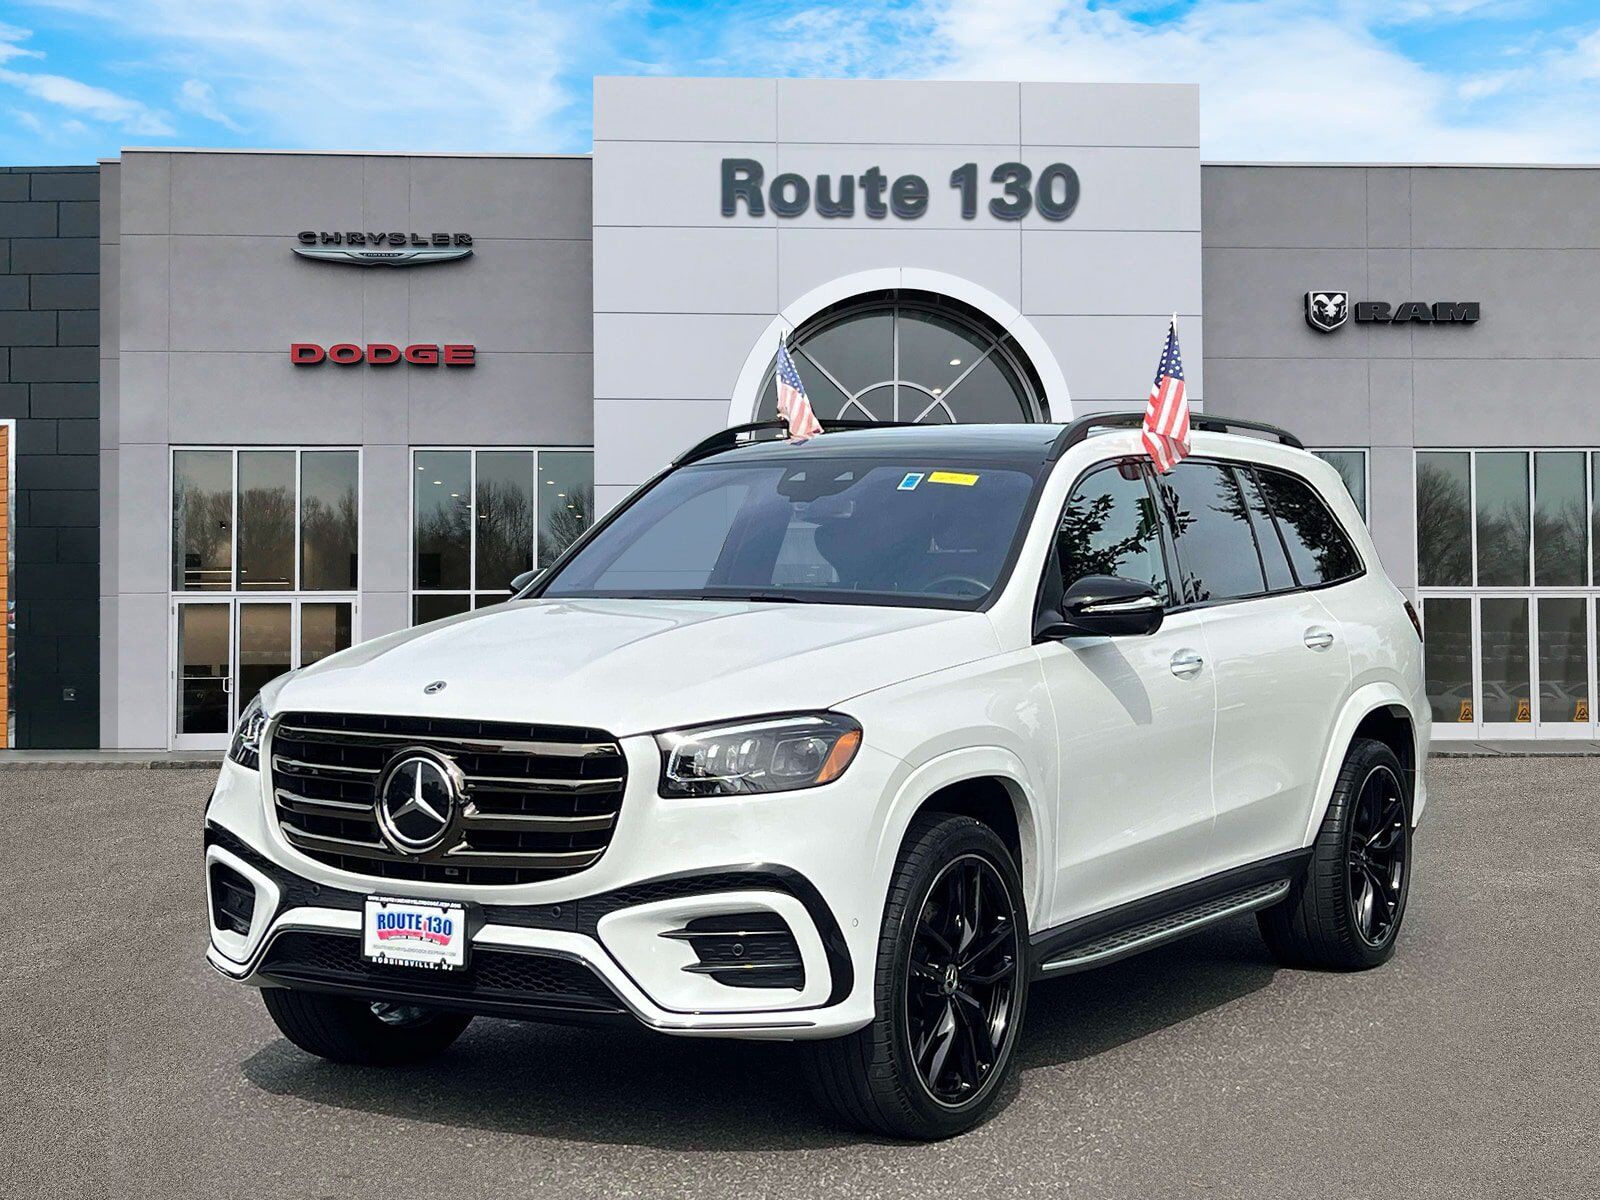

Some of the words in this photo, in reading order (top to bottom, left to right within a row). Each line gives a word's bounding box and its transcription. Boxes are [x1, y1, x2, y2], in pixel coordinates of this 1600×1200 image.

[720, 158, 930, 219] Route
[950, 162, 1081, 221] 130
[298, 231, 473, 246] CHRYSLER
[1354, 302, 1480, 323] RAM
[291, 344, 476, 366] DODGE
[377, 913, 422, 930] ROUTE
[426, 915, 452, 936] 130
